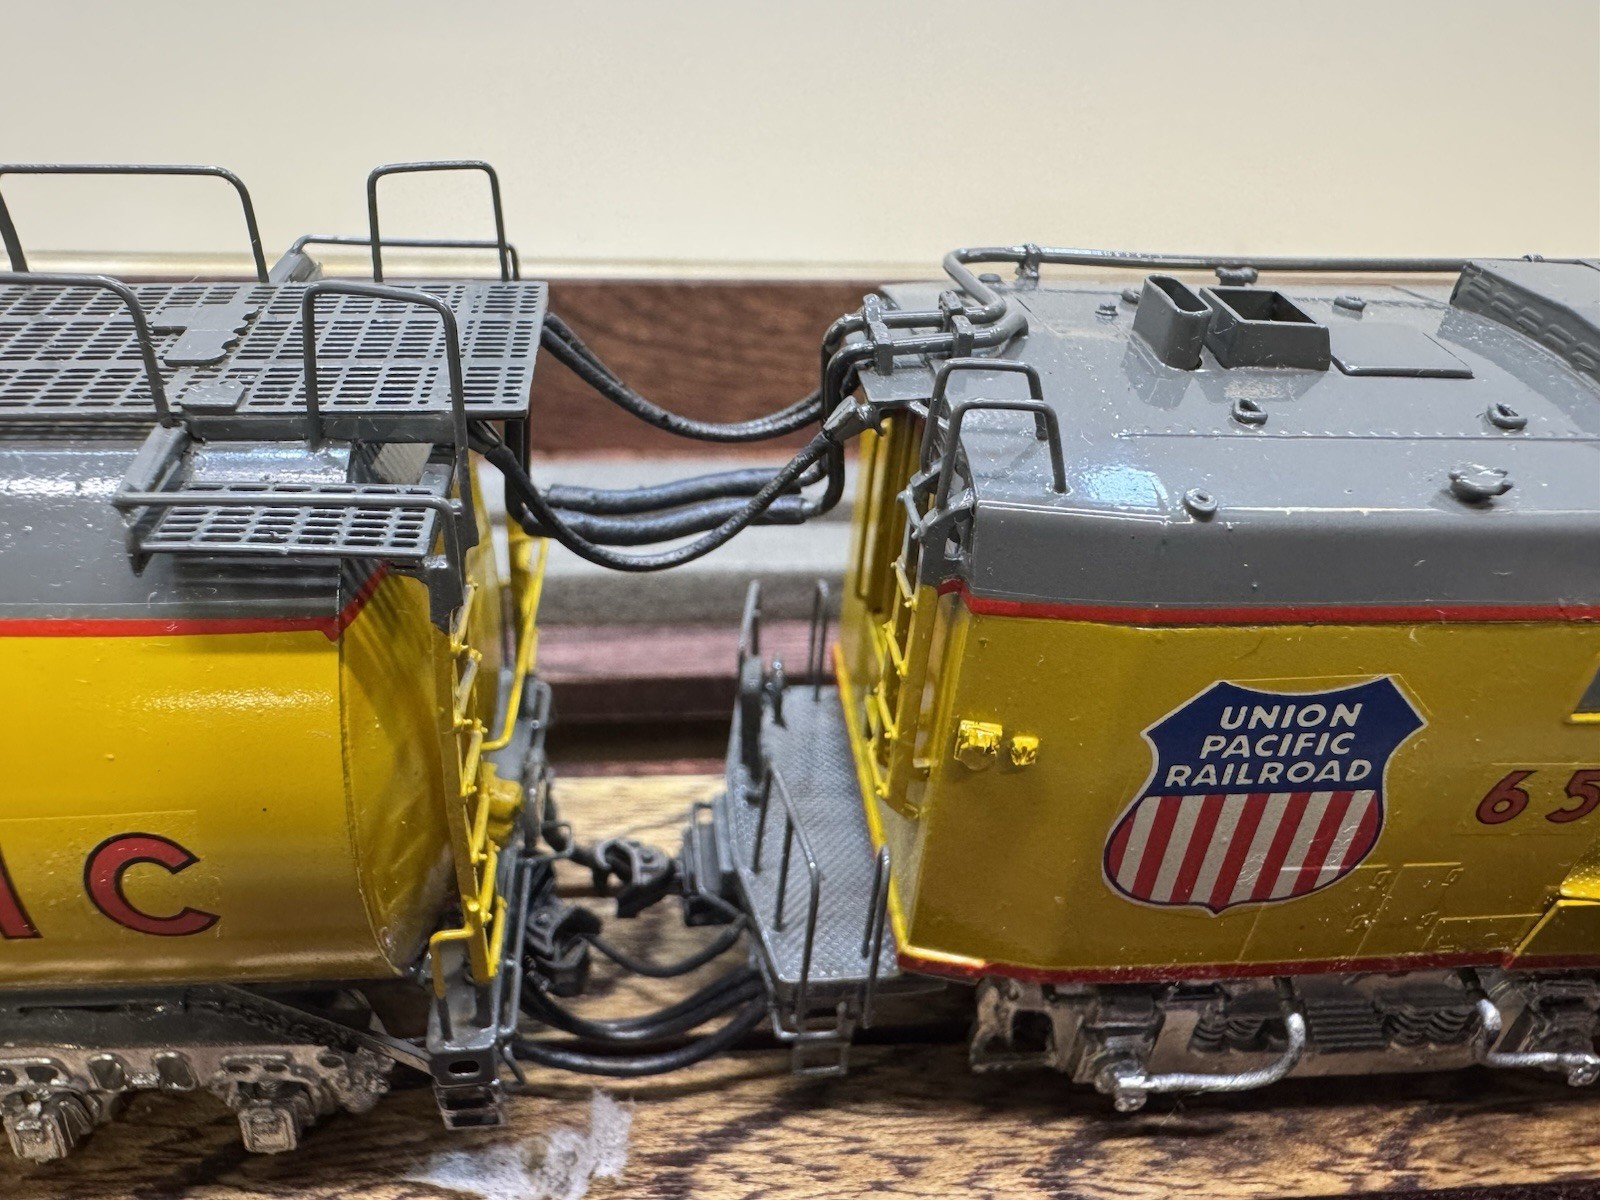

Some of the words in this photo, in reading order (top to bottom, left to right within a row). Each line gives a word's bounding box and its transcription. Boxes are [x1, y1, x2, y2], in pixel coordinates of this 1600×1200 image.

[1219, 703, 1363, 730] UNION
[1199, 732, 1356, 760] PACIFIC
[1164, 758, 1372, 787] RAILROAD
[1475, 769, 1600, 825] 65
